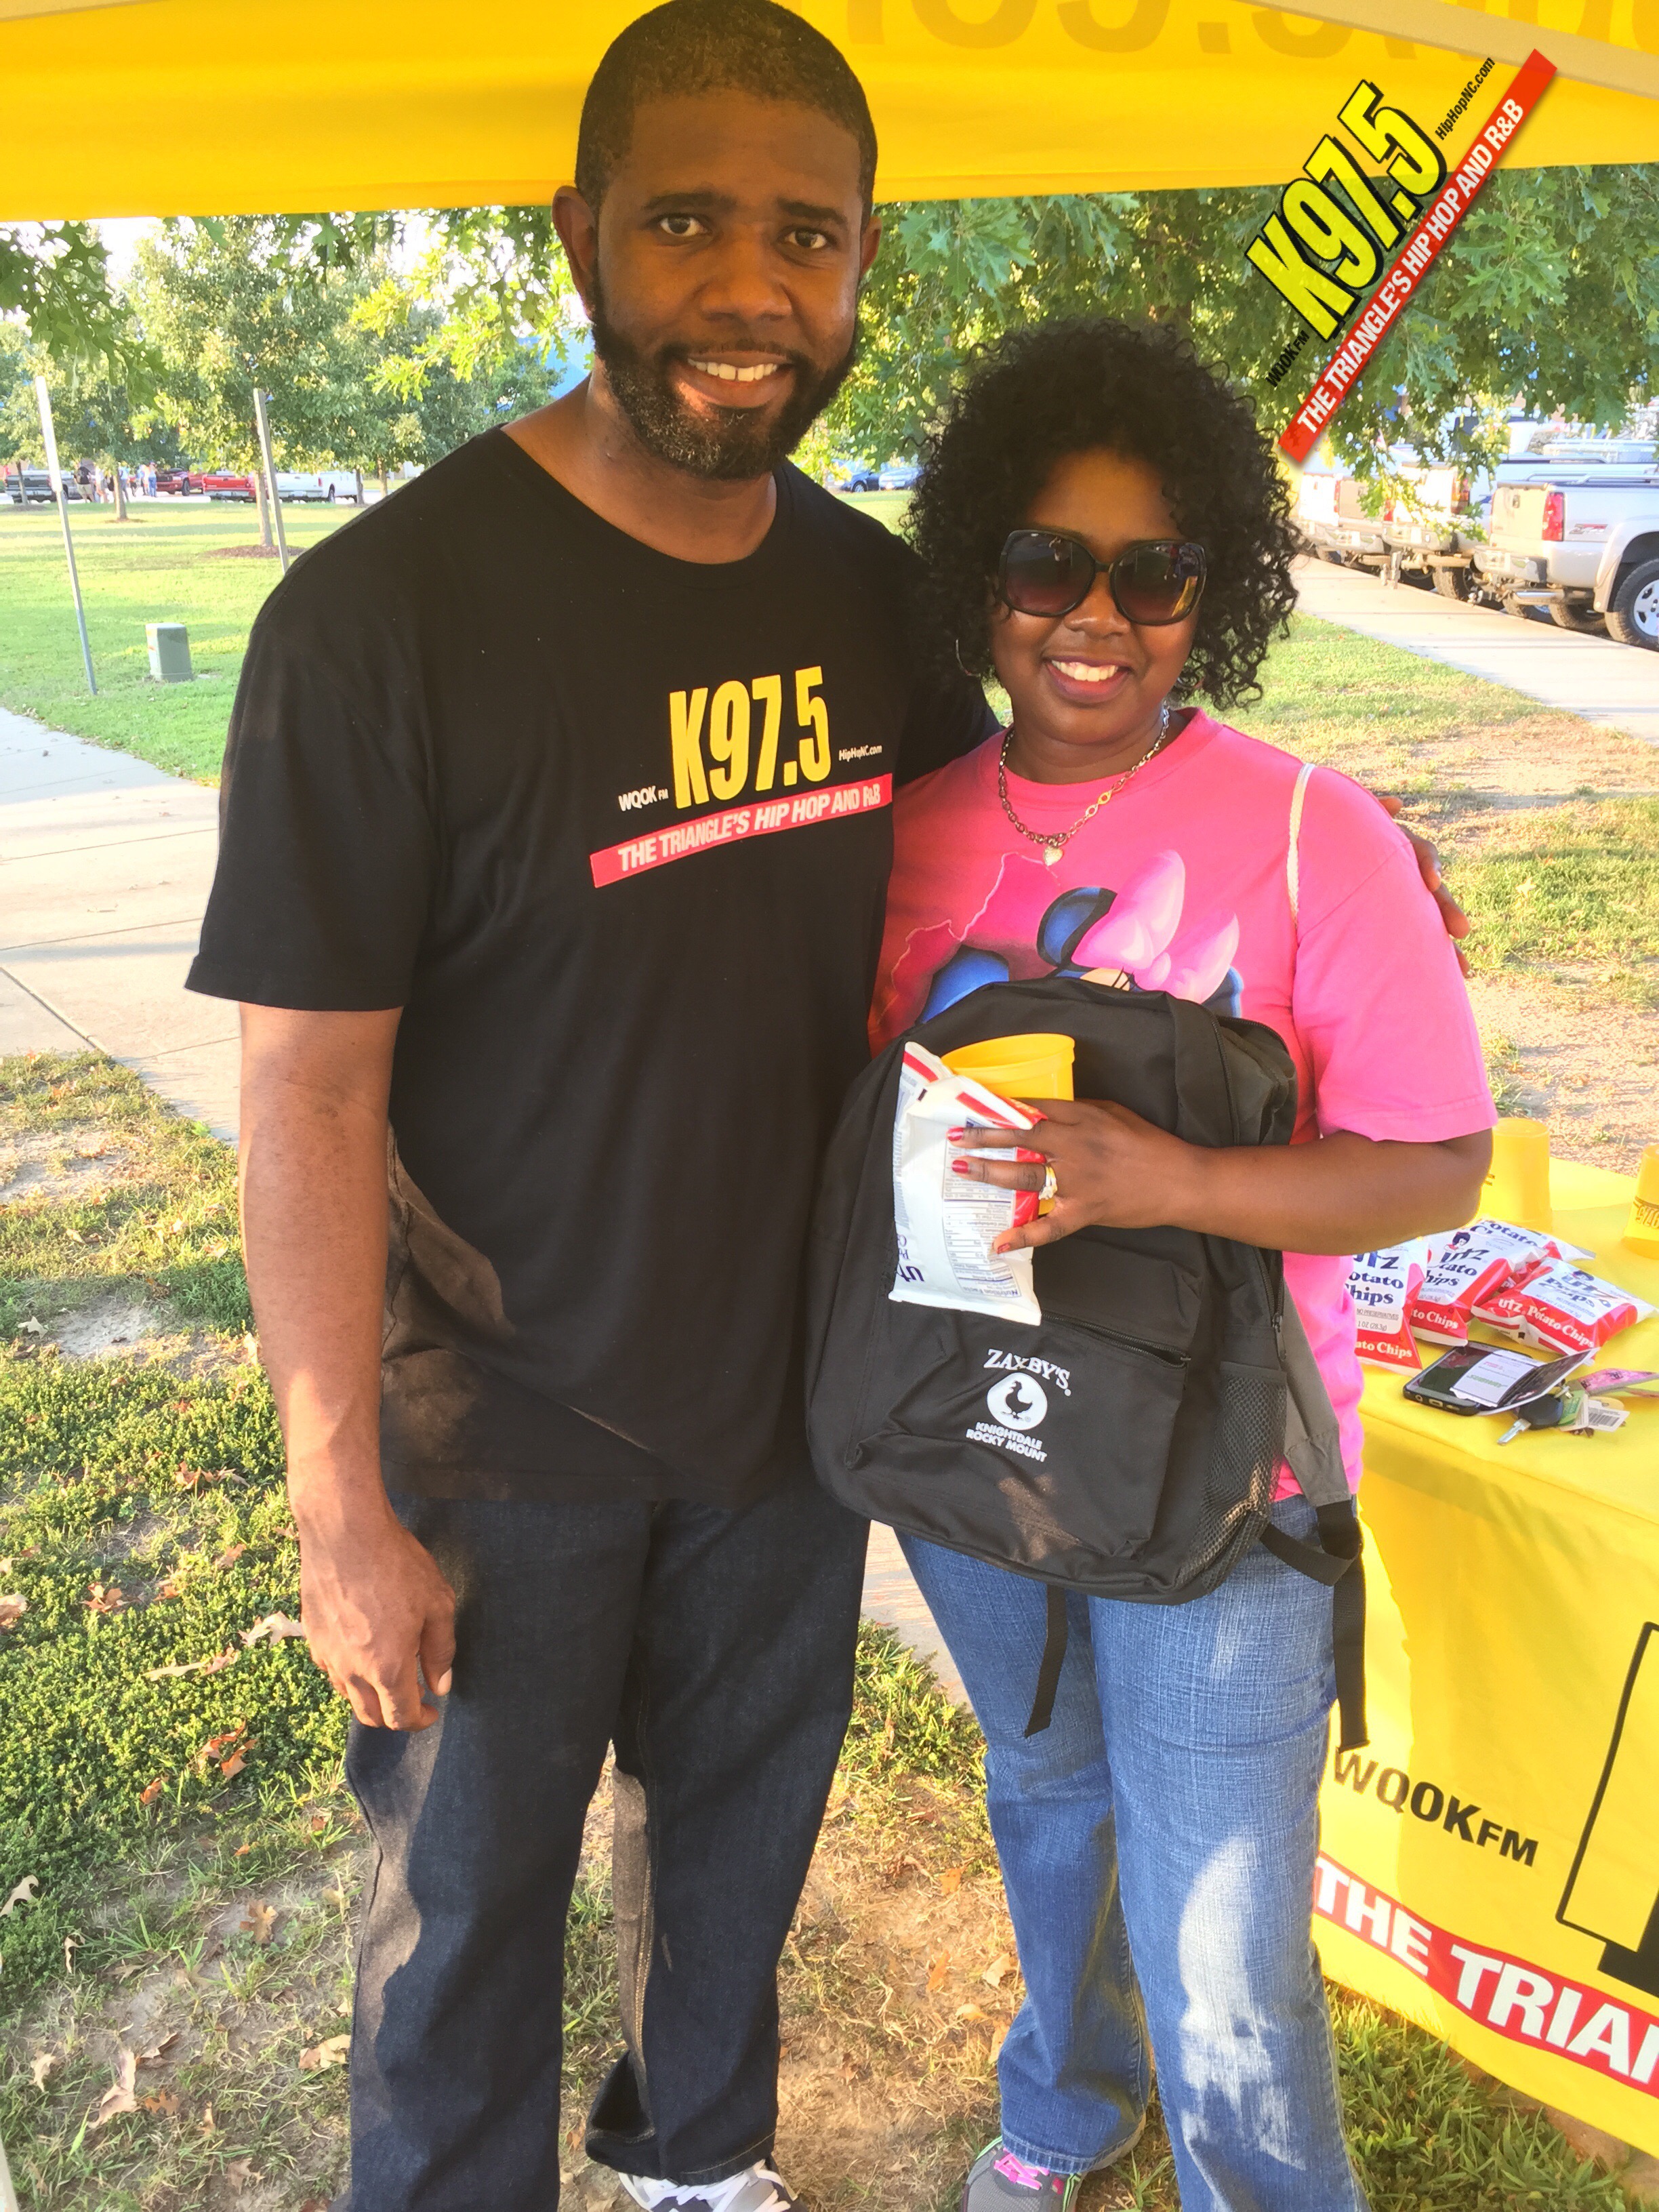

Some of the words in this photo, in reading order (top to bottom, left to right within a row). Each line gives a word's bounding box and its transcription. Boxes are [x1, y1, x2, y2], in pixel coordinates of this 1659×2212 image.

[670, 665, 831, 808] K97.5
[618, 785, 656, 811] WQOK
[658, 788, 668, 801] FM
[618, 842, 656, 872] THE
[659, 811, 750, 858] TRIANGLE'S
[754, 804, 790, 831] HIP
[792, 796, 830, 823] HOP
[832, 788, 860, 814] AND
[863, 783, 880, 807] R&B
[1364, 1309, 1399, 1320] PRESERVATIVES
[1426, 1311, 1459, 1329] Chips
[1526, 1304, 1562, 1330] Potato
[1561, 1325, 1594, 1348] Chips
[1376, 1341, 1413, 1359] Chips
[983, 1349, 1071, 1389] ZAXBY'S
[966, 1429, 1005, 1446] ROCKY
[1006, 1441, 1048, 1462] MOUNT
[976, 1422, 1043, 1450] KNIGHTDALE
[1315, 1856, 1433, 1978] THE
